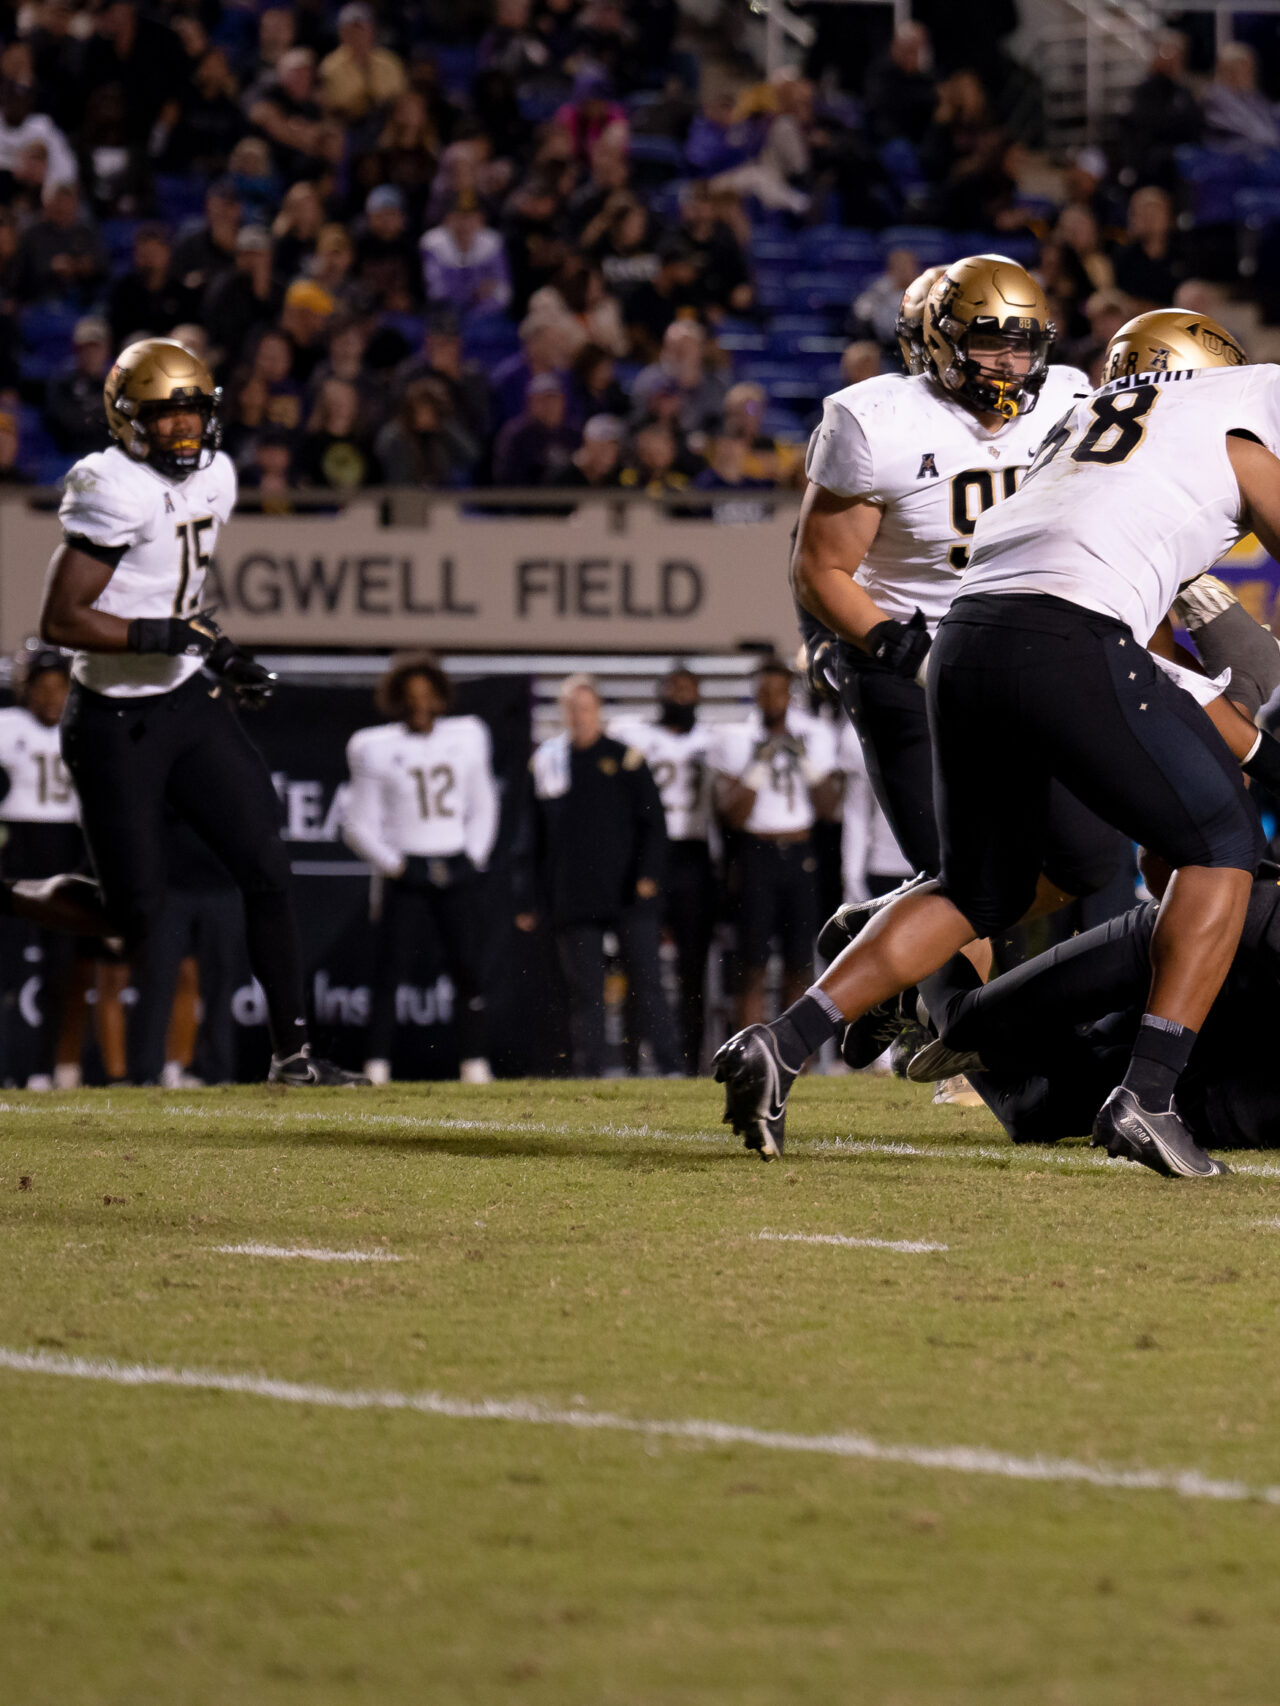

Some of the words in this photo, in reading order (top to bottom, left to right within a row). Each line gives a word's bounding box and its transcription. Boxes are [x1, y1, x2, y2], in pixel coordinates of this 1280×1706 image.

[173, 515, 213, 617] 15
[205, 554, 476, 614] AGWELL
[515, 558, 705, 617] FIELD
[409, 764, 456, 819] 12
